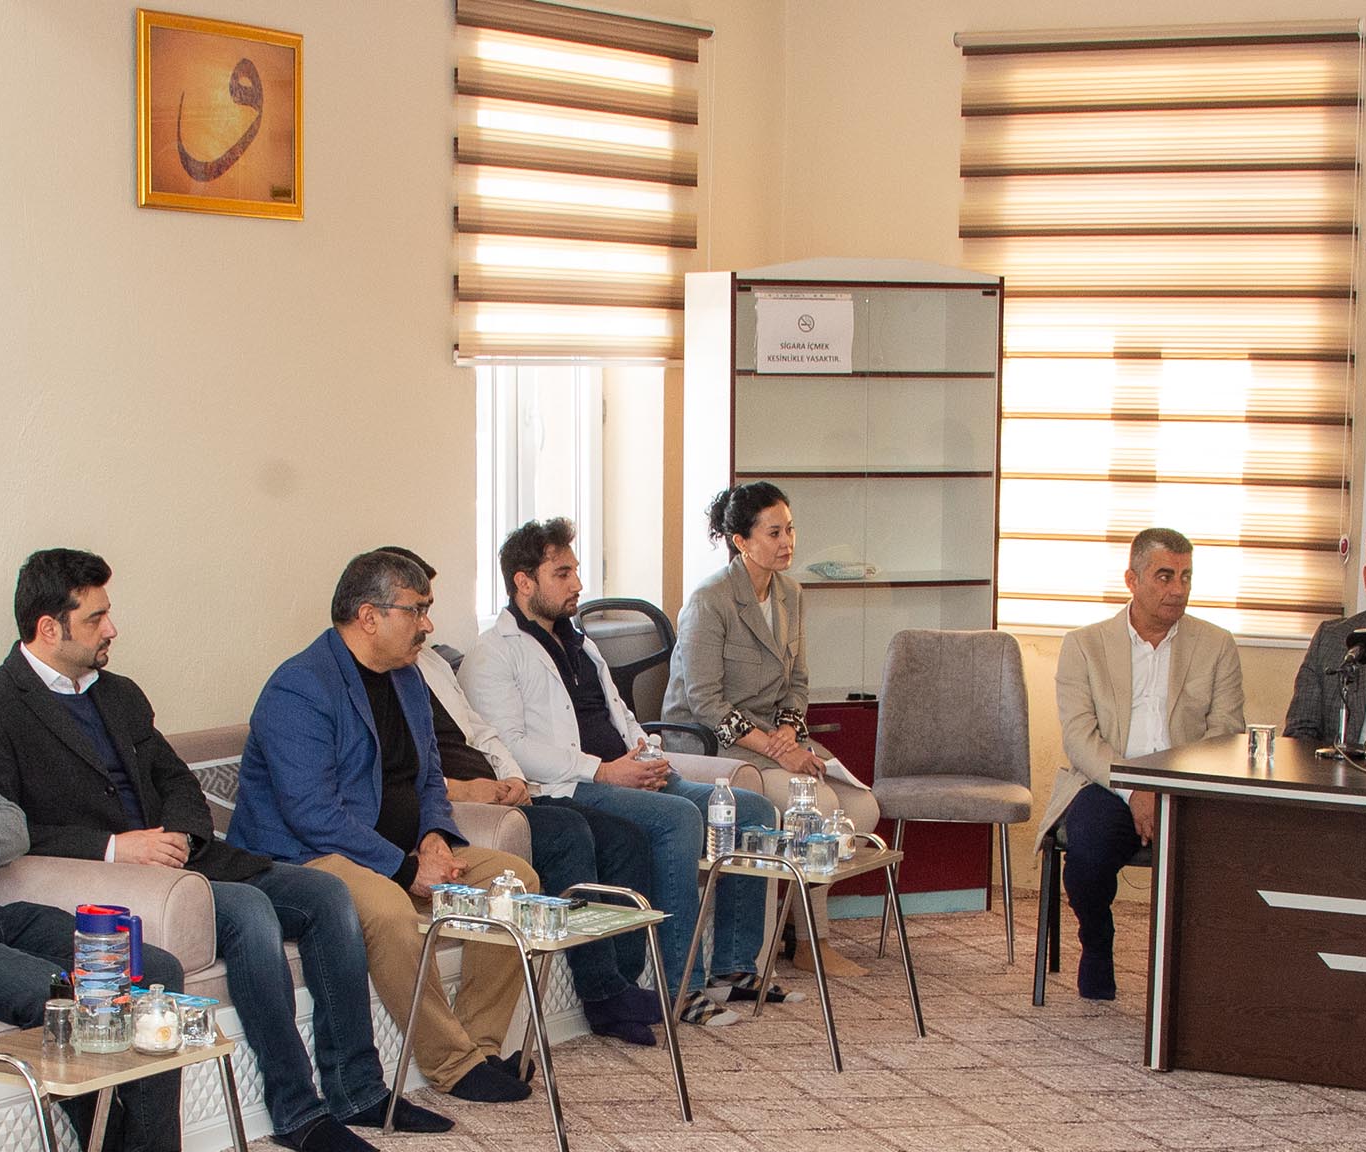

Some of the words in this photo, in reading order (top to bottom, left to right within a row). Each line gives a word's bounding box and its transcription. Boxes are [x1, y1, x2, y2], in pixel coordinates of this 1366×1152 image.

[779, 341, 806, 350] SİGARA
[807, 341, 830, 351] İÇMEK
[767, 353, 804, 362] KESİNLİKLE
